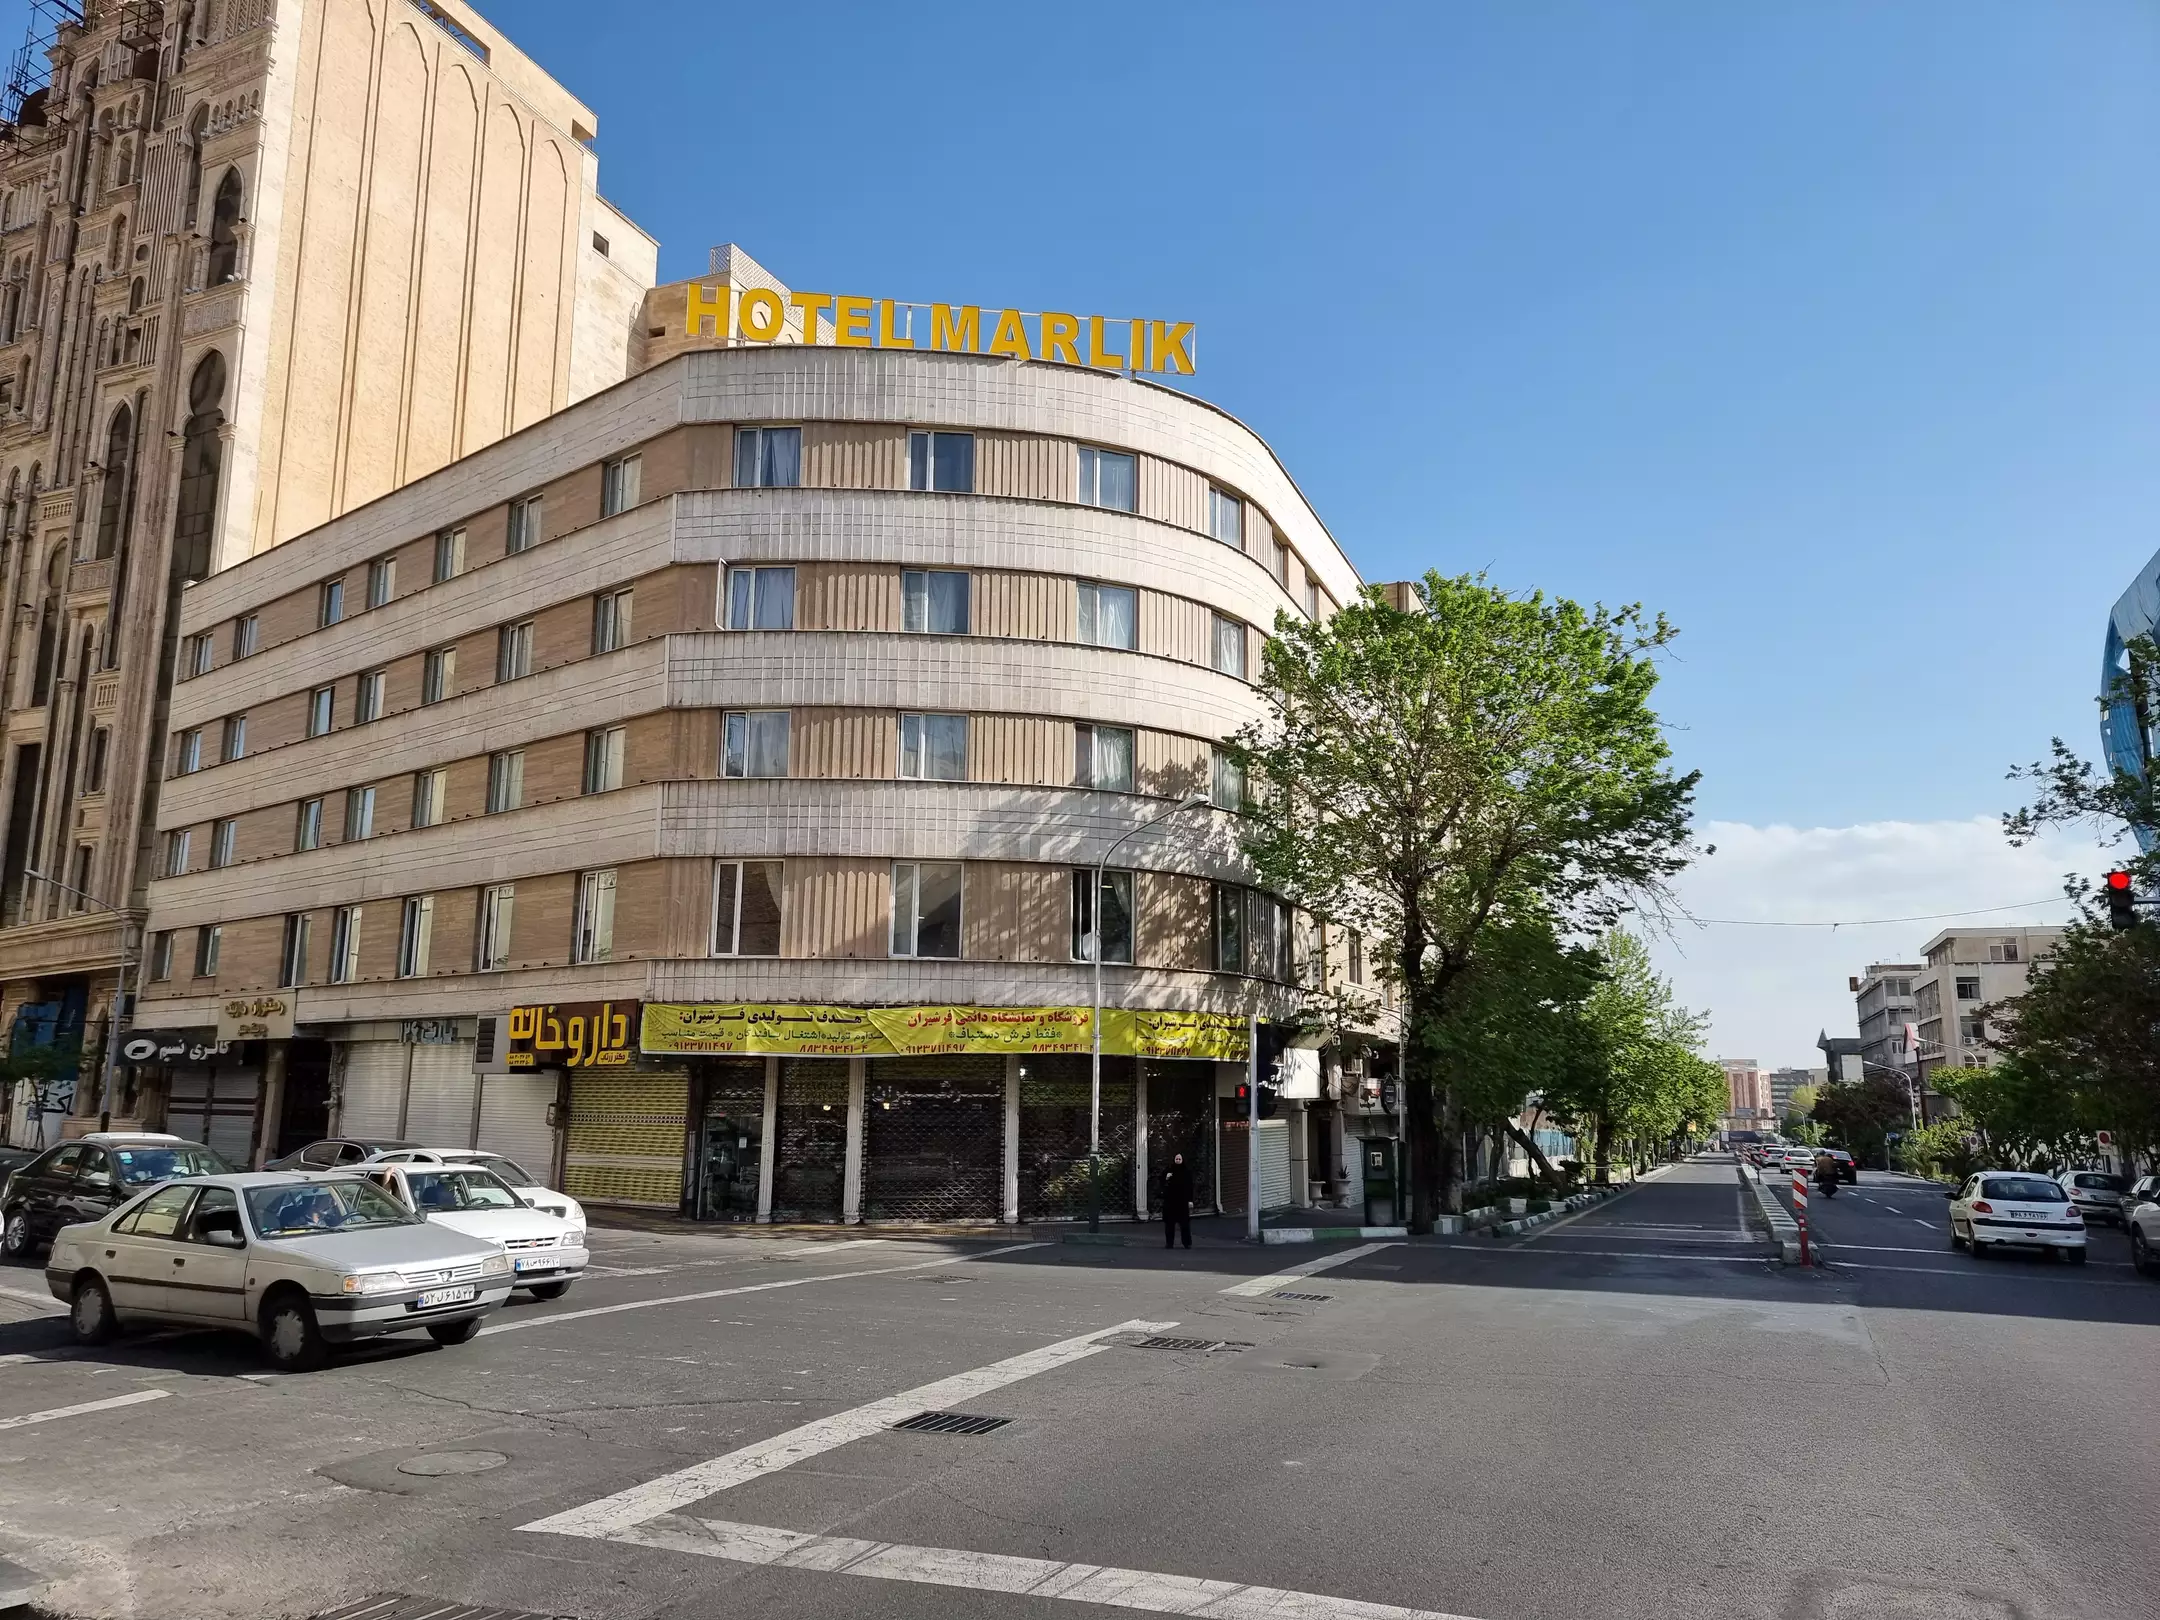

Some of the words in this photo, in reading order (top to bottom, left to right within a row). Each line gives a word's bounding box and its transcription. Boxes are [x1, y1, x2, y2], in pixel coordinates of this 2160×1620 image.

[686, 282, 915, 348] HOTEL
[930, 303, 1195, 375] MARLIK
[747, 1009, 814, 1025] تولیدی
[816, 1010, 862, 1023] هدف
[907, 1010, 953, 1027] فرشیران
[991, 1011, 1036, 1026] نمایشگاه
[1039, 1016, 1045, 1026] و
[1047, 1009, 1088, 1026] فروشگاه
[508, 1003, 627, 1067] داروخانه
[661, 1028, 696, 1039] مناسب
[698, 1028, 725, 1039] قیمت
[1003, 1027, 1031, 1043] فرش
[159, 1038, 186, 1063] نسیم
